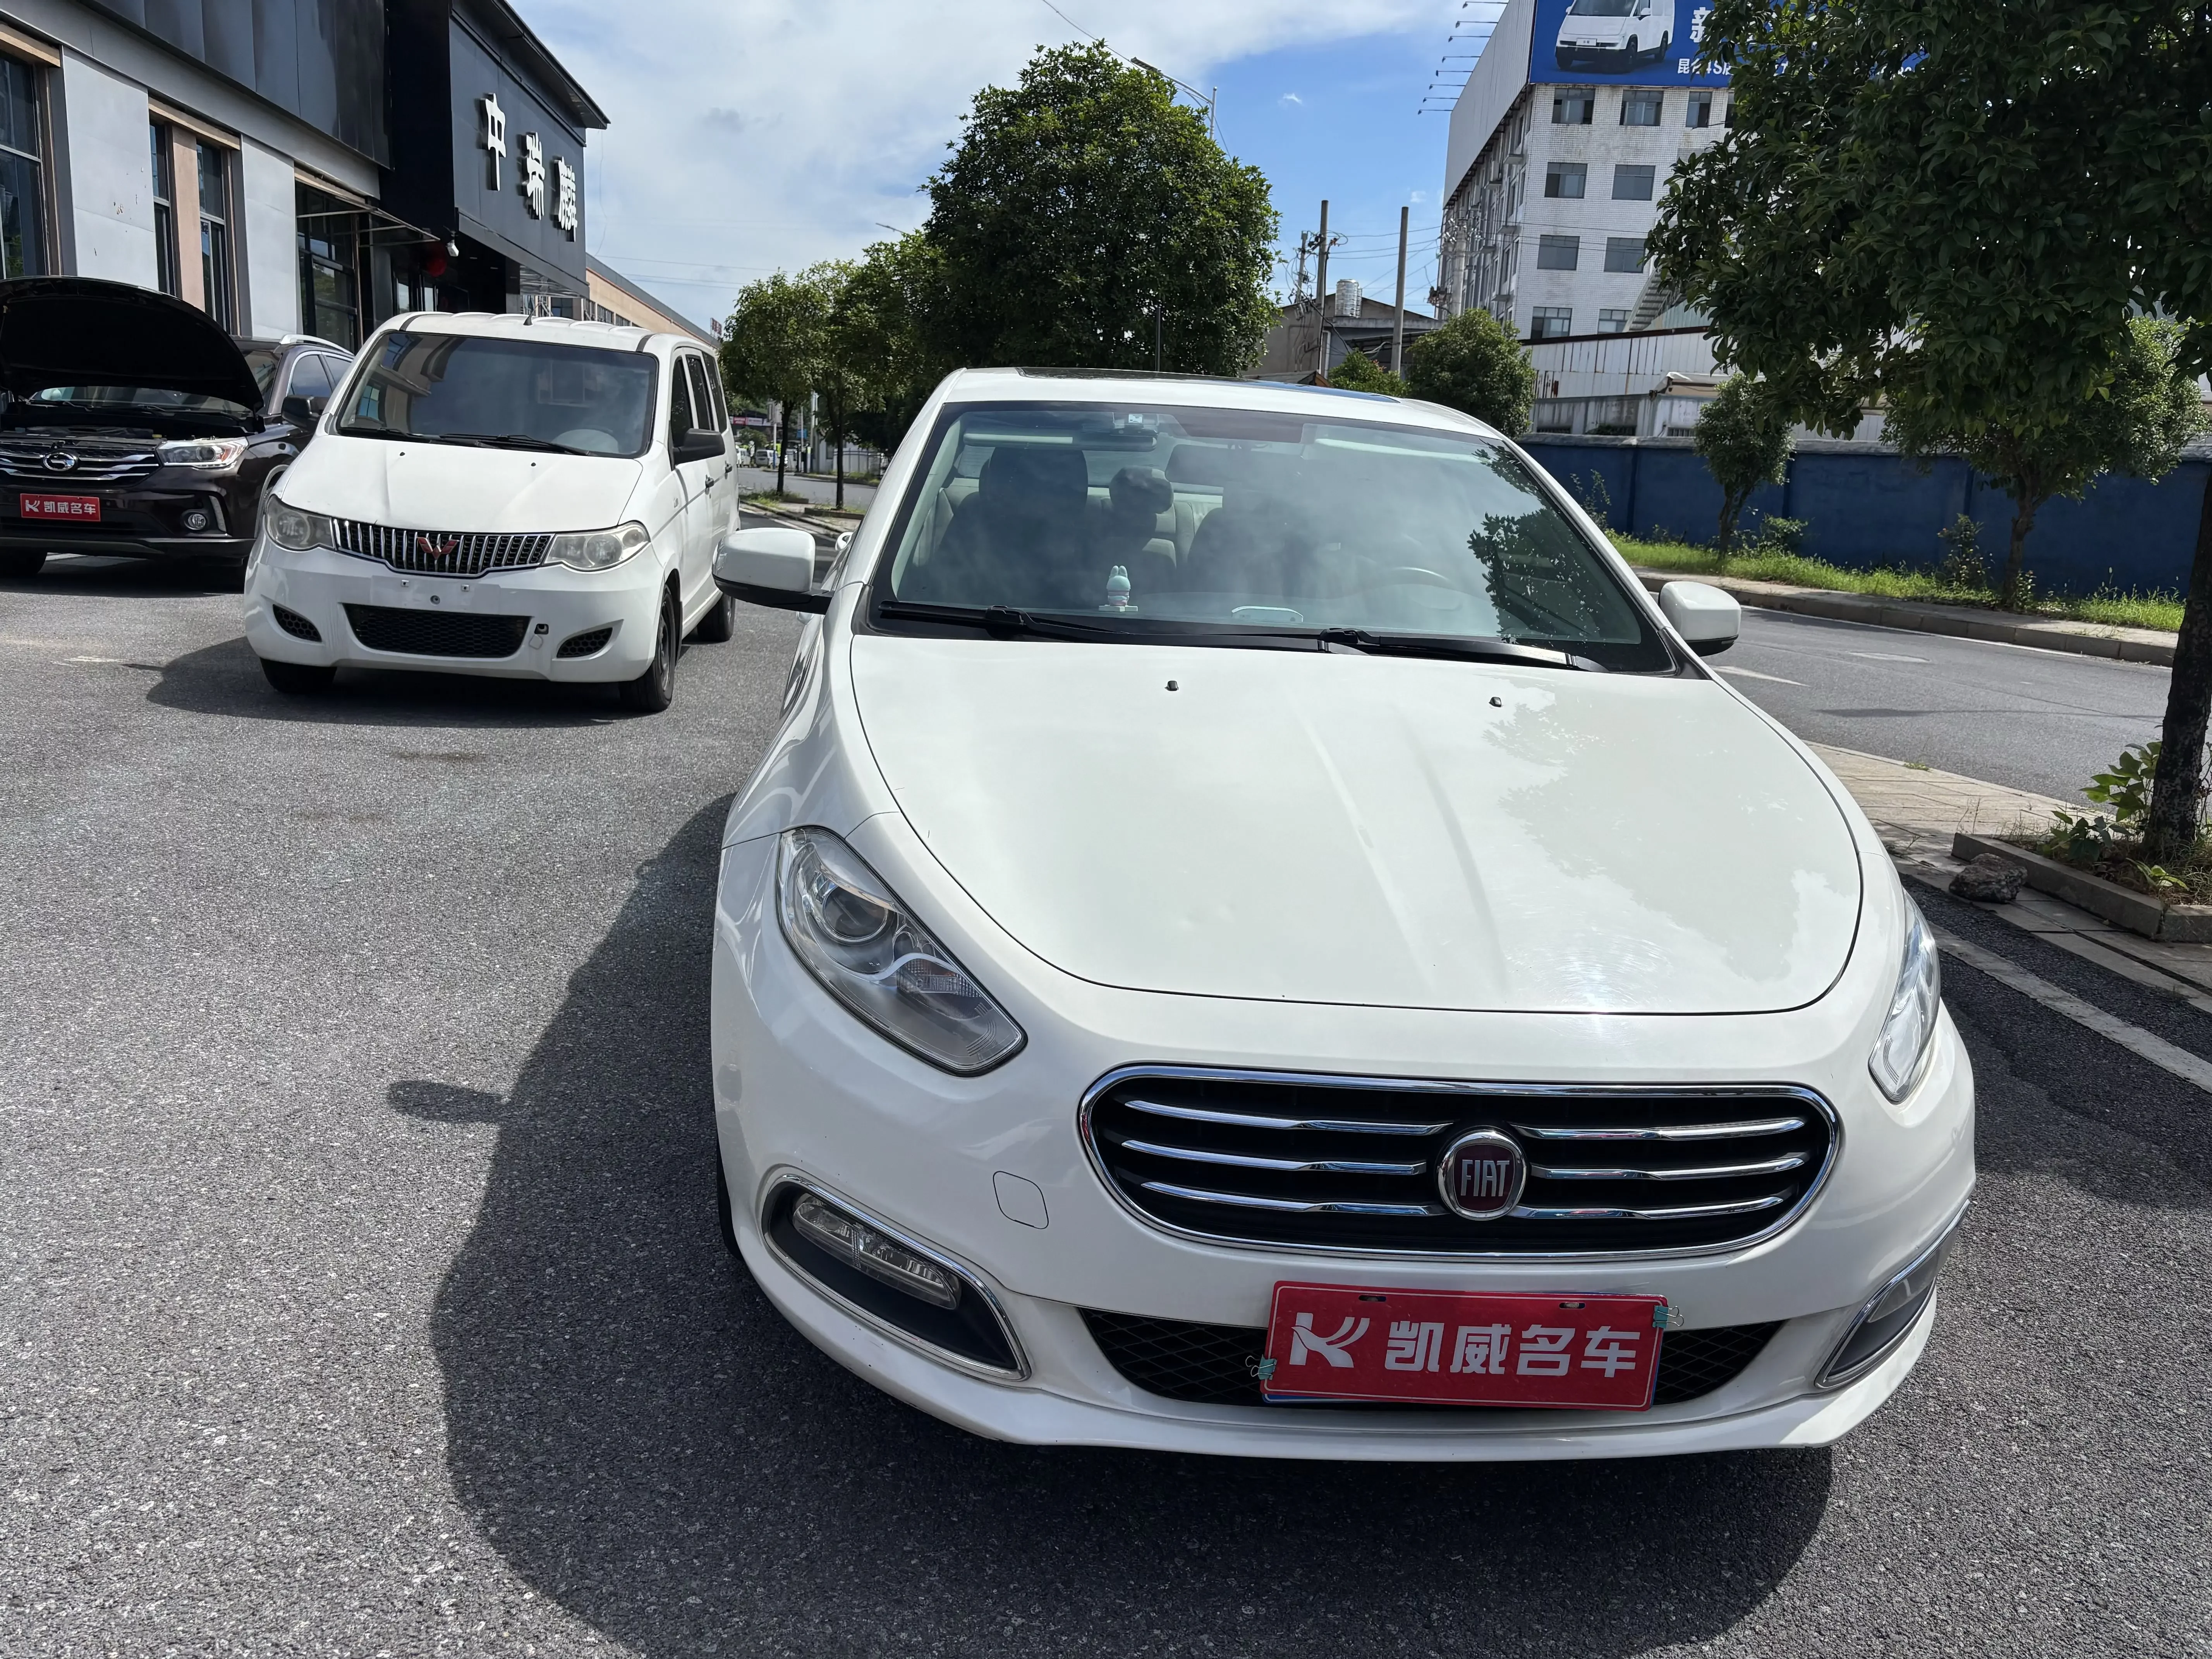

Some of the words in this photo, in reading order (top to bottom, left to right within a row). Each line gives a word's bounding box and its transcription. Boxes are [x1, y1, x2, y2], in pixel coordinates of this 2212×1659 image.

[481, 93, 577, 242] 中瑞麟
[44, 501, 96, 515] 凯威名车
[1460, 1159, 1510, 1197] FIAT
[1384, 1321, 1641, 1378] 凯威名车
